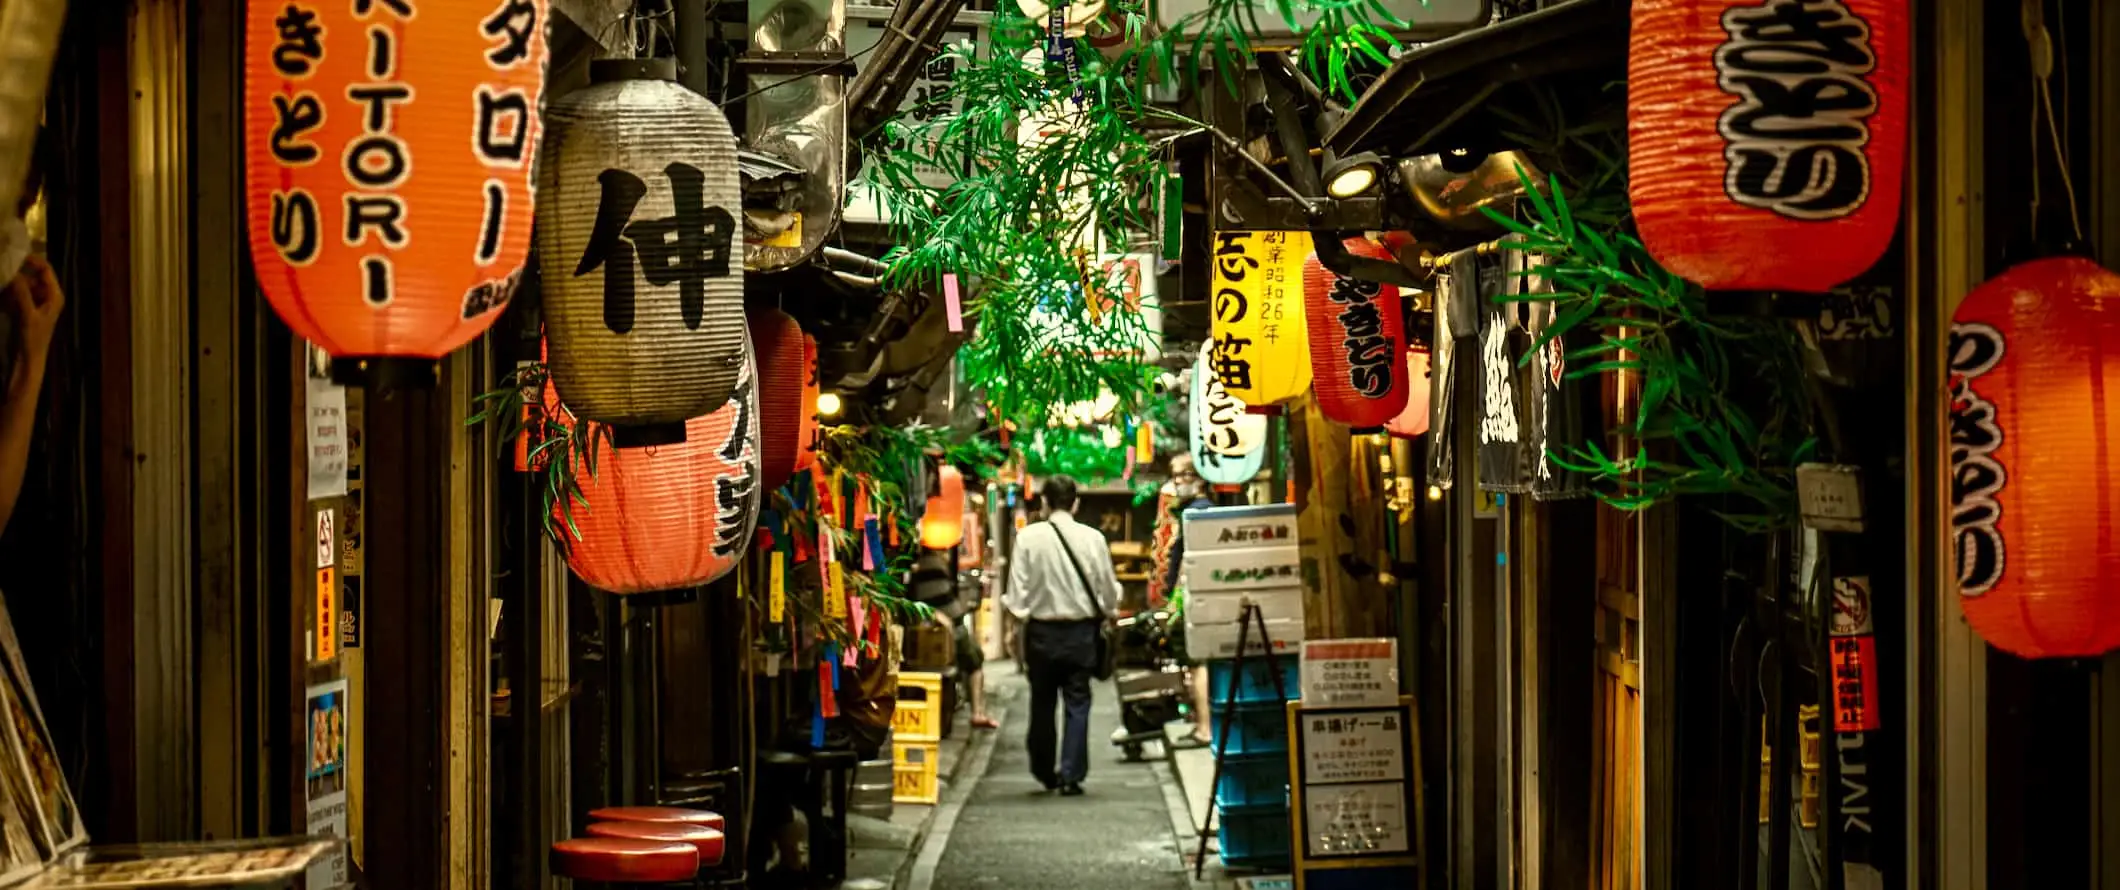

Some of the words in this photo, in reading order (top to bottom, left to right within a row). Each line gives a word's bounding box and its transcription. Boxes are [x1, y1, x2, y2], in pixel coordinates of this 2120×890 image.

[270, 3, 326, 264] きとり
[574, 161, 736, 334] 伸
